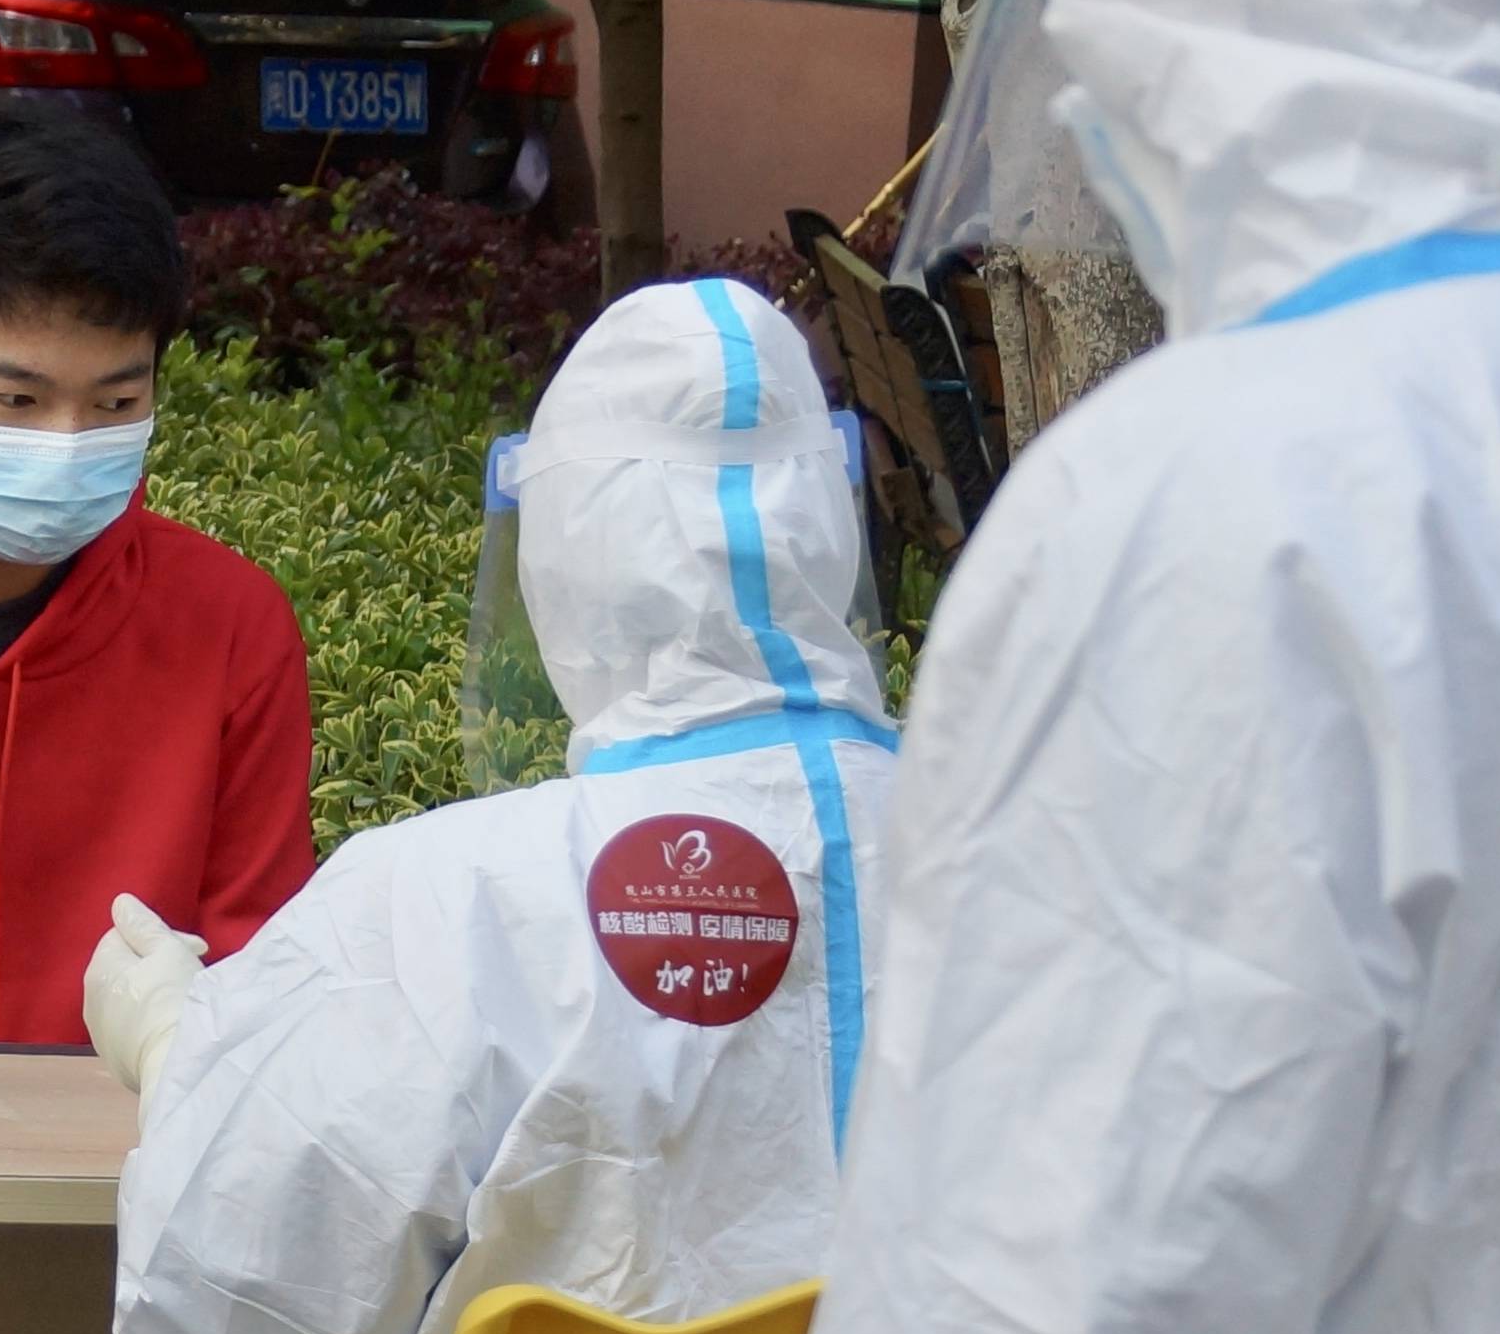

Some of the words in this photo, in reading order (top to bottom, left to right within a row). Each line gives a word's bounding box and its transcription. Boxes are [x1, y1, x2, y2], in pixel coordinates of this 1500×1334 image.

[597, 910, 693, 936] 核酸检测
[699, 914, 791, 942] 疫情保障
